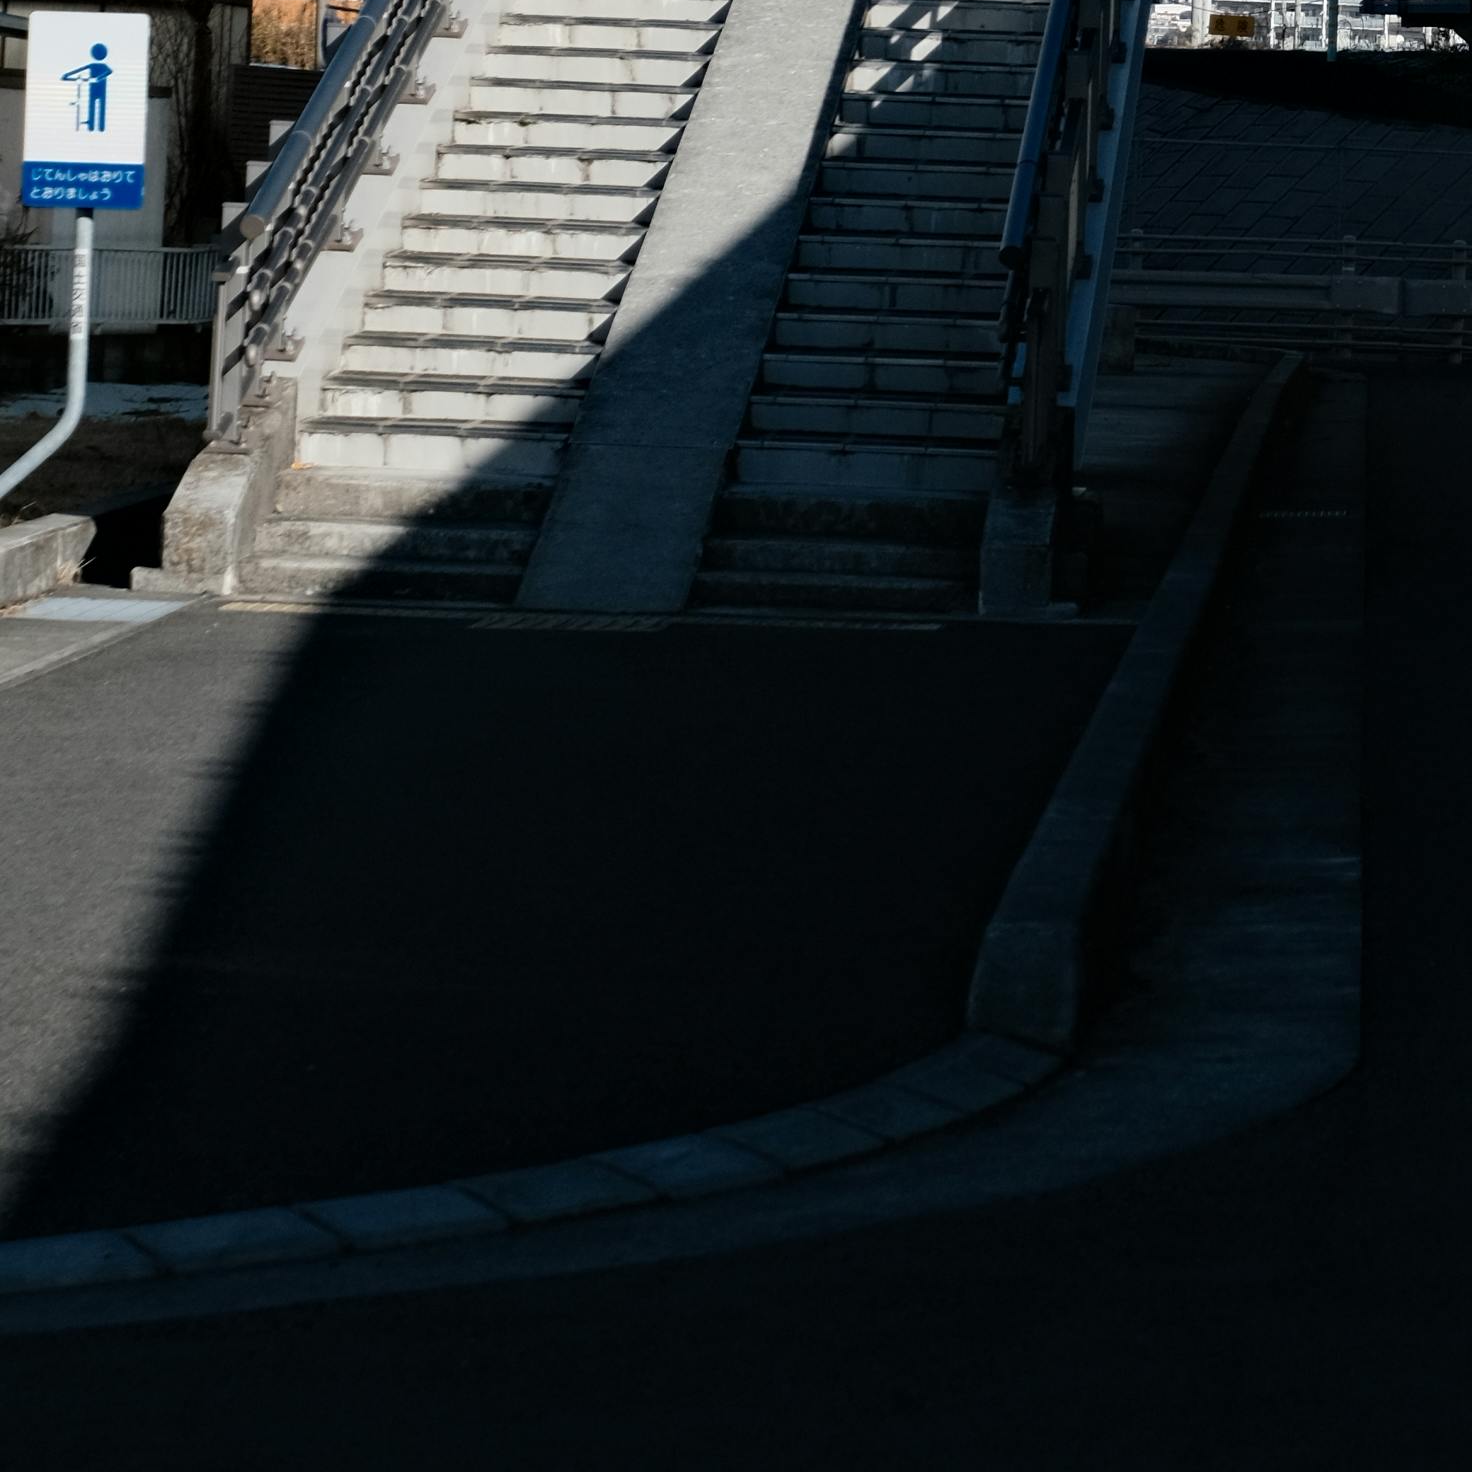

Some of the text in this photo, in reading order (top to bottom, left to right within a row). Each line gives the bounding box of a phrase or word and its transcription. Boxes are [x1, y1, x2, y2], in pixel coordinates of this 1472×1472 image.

[31, 168, 136, 183] じてんしゃはおりて
[30, 186, 112, 201] とおりましょう
